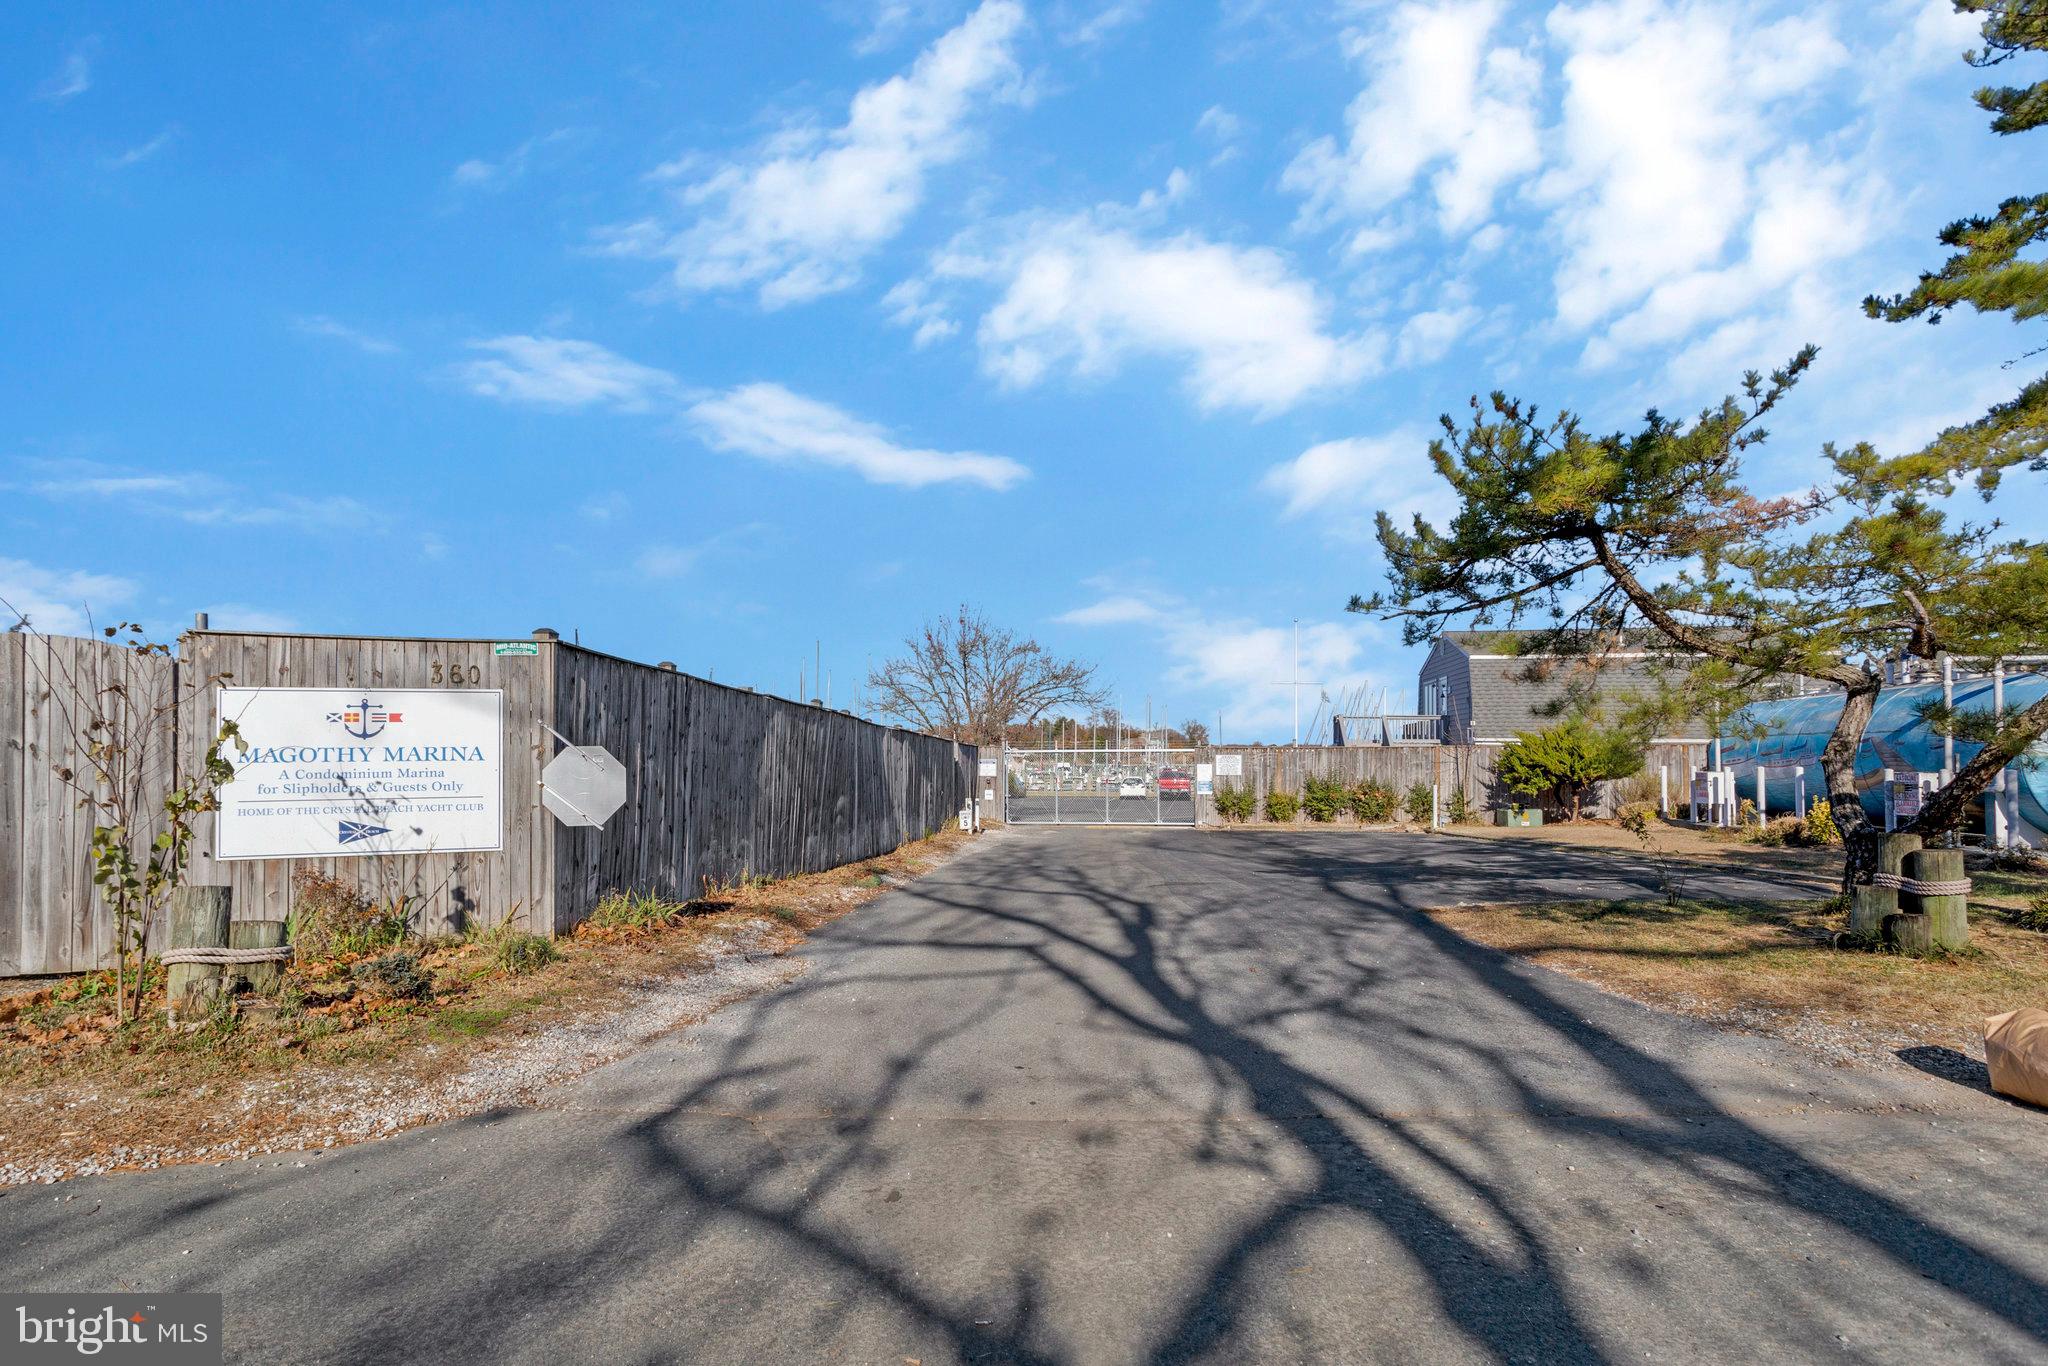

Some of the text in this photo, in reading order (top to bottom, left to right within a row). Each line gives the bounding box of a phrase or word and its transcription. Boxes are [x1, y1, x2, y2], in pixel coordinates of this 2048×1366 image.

[431, 660, 480, 684] 360
[237, 745, 485, 764] MAGOTHY MARINA
[278, 767, 445, 780] A Condominium Marina
[257, 780, 463, 797] for Slipholders & Guests Only
[237, 802, 484, 817] HOME OF THE CRYSTAL BEACH YACHT CLUB
[963, 819, 969, 827] 5
